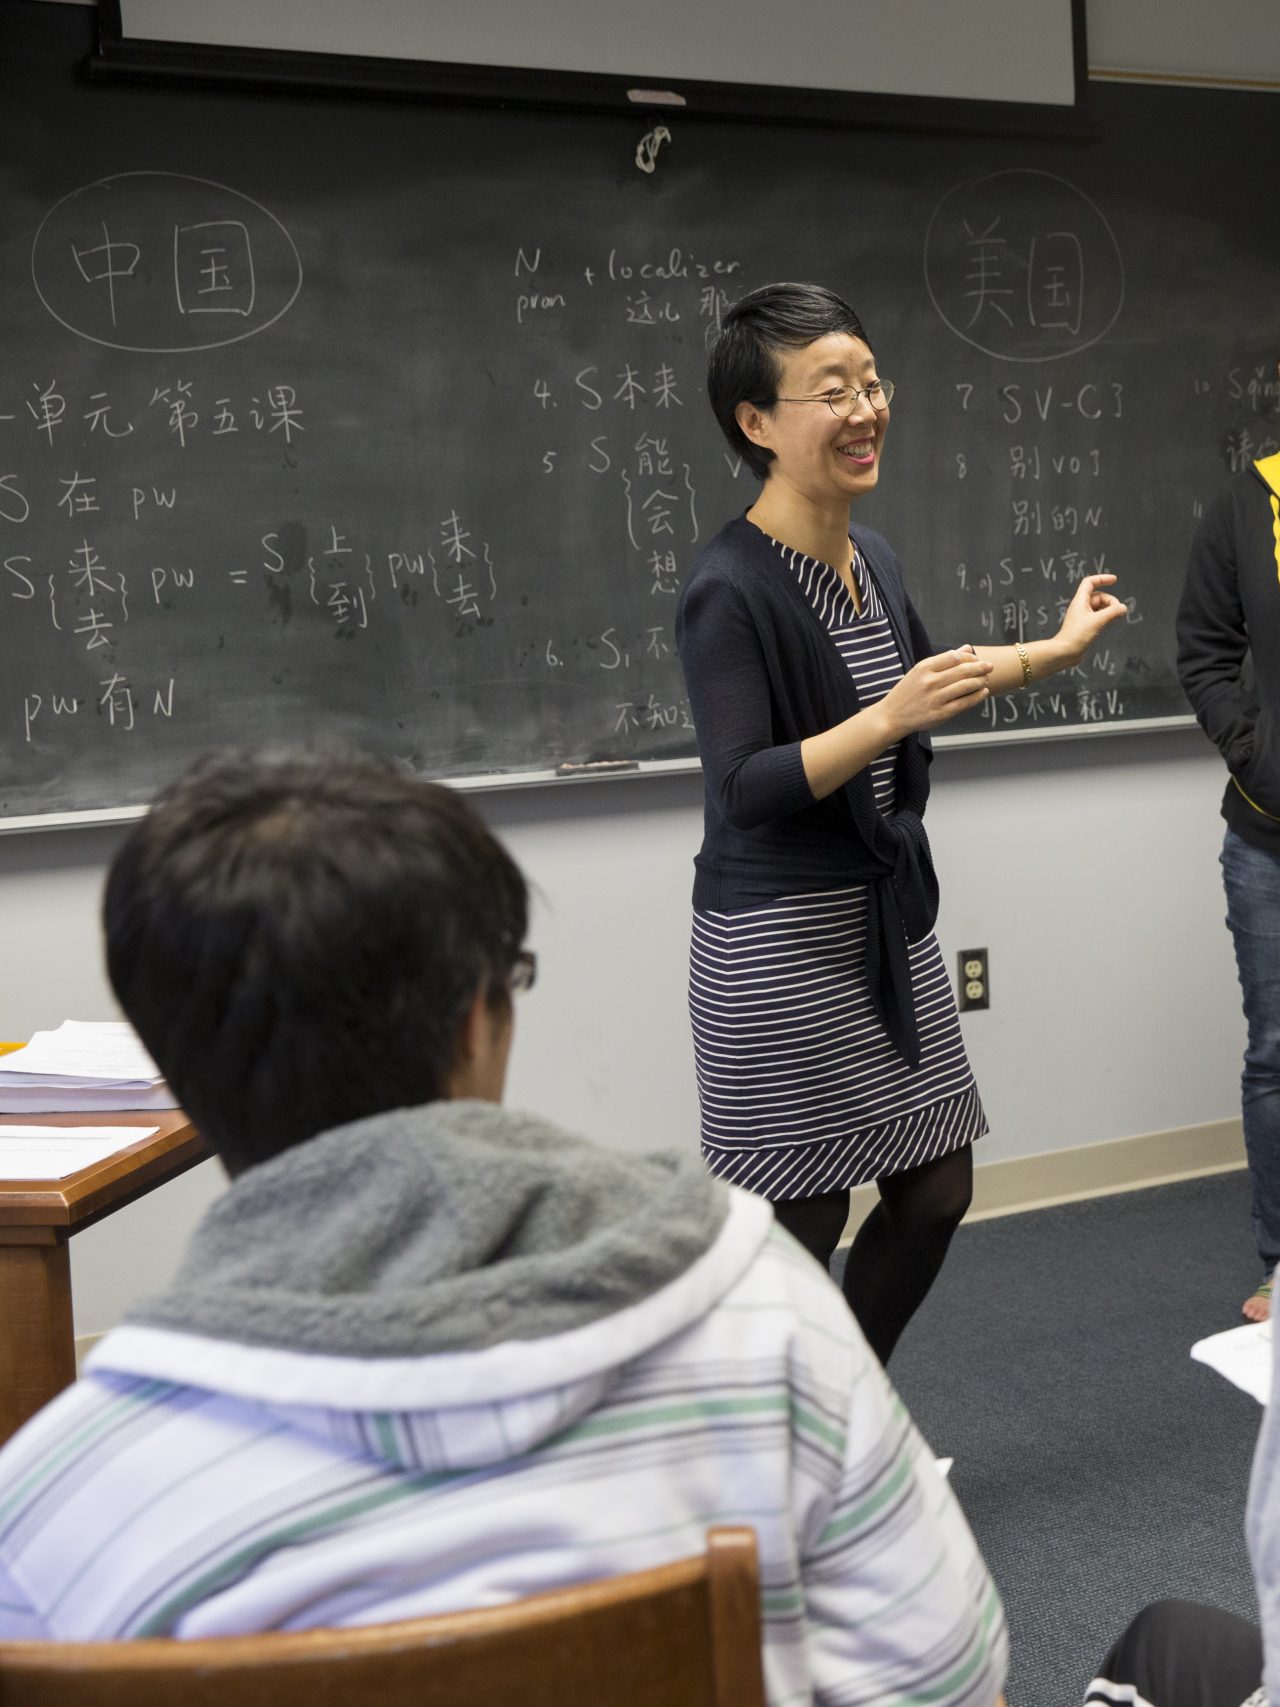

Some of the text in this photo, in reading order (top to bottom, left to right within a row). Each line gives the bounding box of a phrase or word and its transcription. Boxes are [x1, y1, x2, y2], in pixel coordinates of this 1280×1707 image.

[71, 220, 256, 328] 中国
[608, 247, 741, 281] localizer
[963, 215, 1085, 335] 美国
[58, 471, 100, 518] 在
[642, 488, 679, 534] 会
[325, 526, 352, 555] 上
[440, 508, 477, 562] 来
[68, 539, 116, 596] 来
[327, 582, 368, 628] 到
[446, 574, 481, 618] 去
[74, 608, 113, 650] 去
[100, 673, 134, 731] 有
